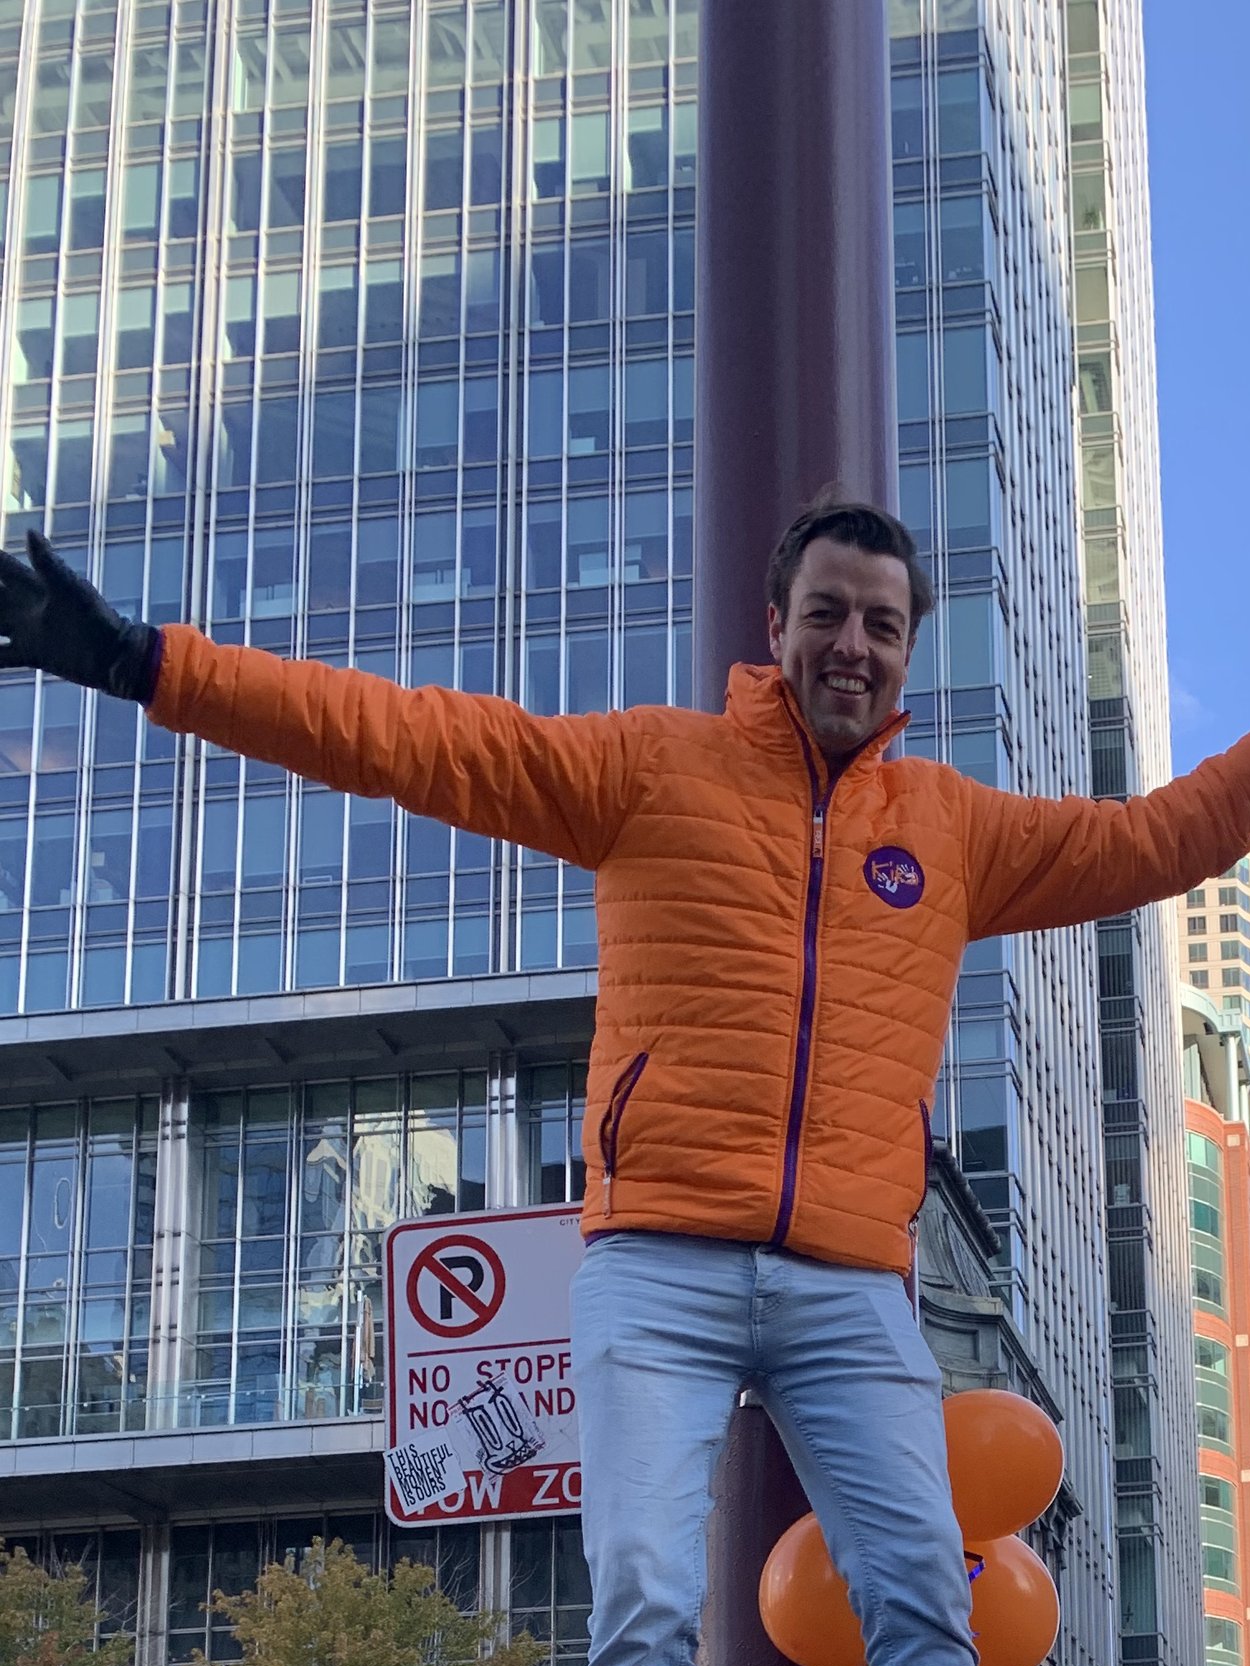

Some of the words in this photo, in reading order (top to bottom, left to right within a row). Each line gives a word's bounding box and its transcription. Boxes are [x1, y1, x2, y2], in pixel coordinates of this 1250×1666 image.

[408, 1365, 450, 1396] NO
[409, 1400, 450, 1430] NO
[387, 1443, 418, 1468] THIS
[394, 1443, 453, 1481] BEAUTIFUL
[398, 1460, 447, 1495] MOMENT
[400, 1482, 416, 1506] IS
[415, 1476, 446, 1501] OURS
